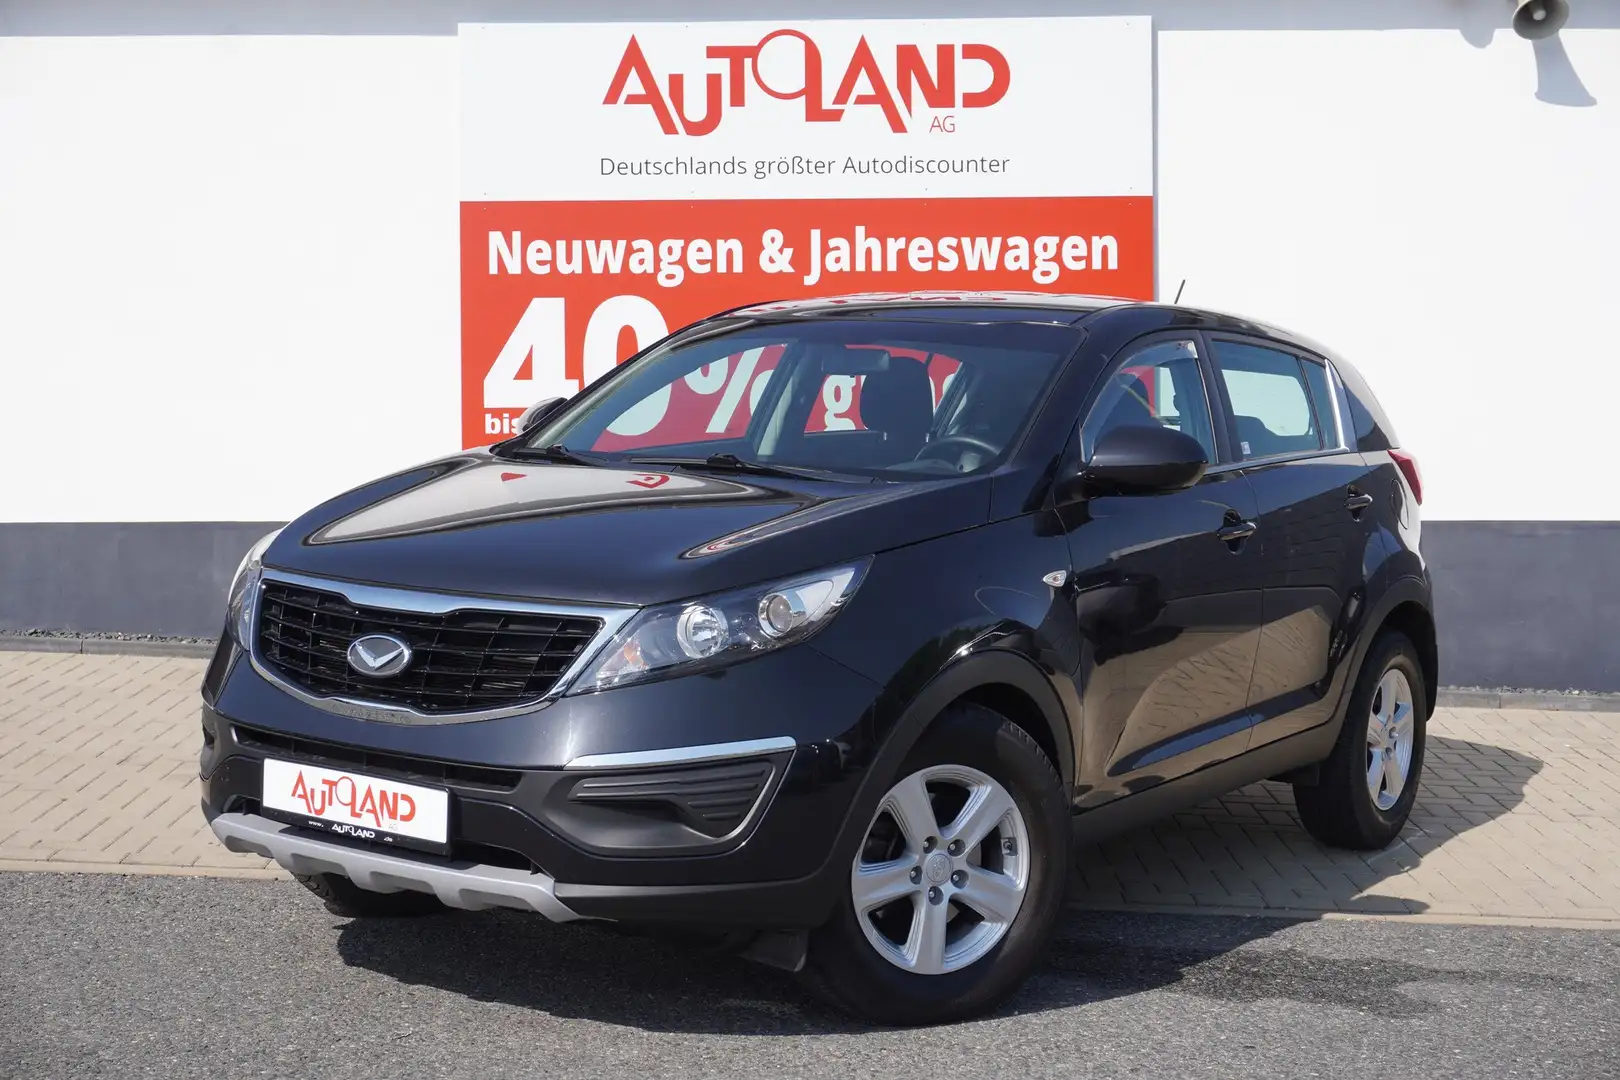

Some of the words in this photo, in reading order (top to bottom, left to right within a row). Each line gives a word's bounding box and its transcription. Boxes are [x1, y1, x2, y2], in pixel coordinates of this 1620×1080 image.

[603, 29, 1011, 137] AUTOLAND
[929, 115, 956, 133] AG
[600, 156, 747, 176] Deutschlands
[753, 156, 836, 180] größter
[842, 155, 1010, 175] Autodiscounter
[487, 230, 744, 288] Neuwagen
[759, 228, 795, 274] &
[803, 226, 1119, 287] Jahreswagen
[291, 770, 416, 828] AUTOLAND
[331, 823, 376, 838] AUTOLAND
